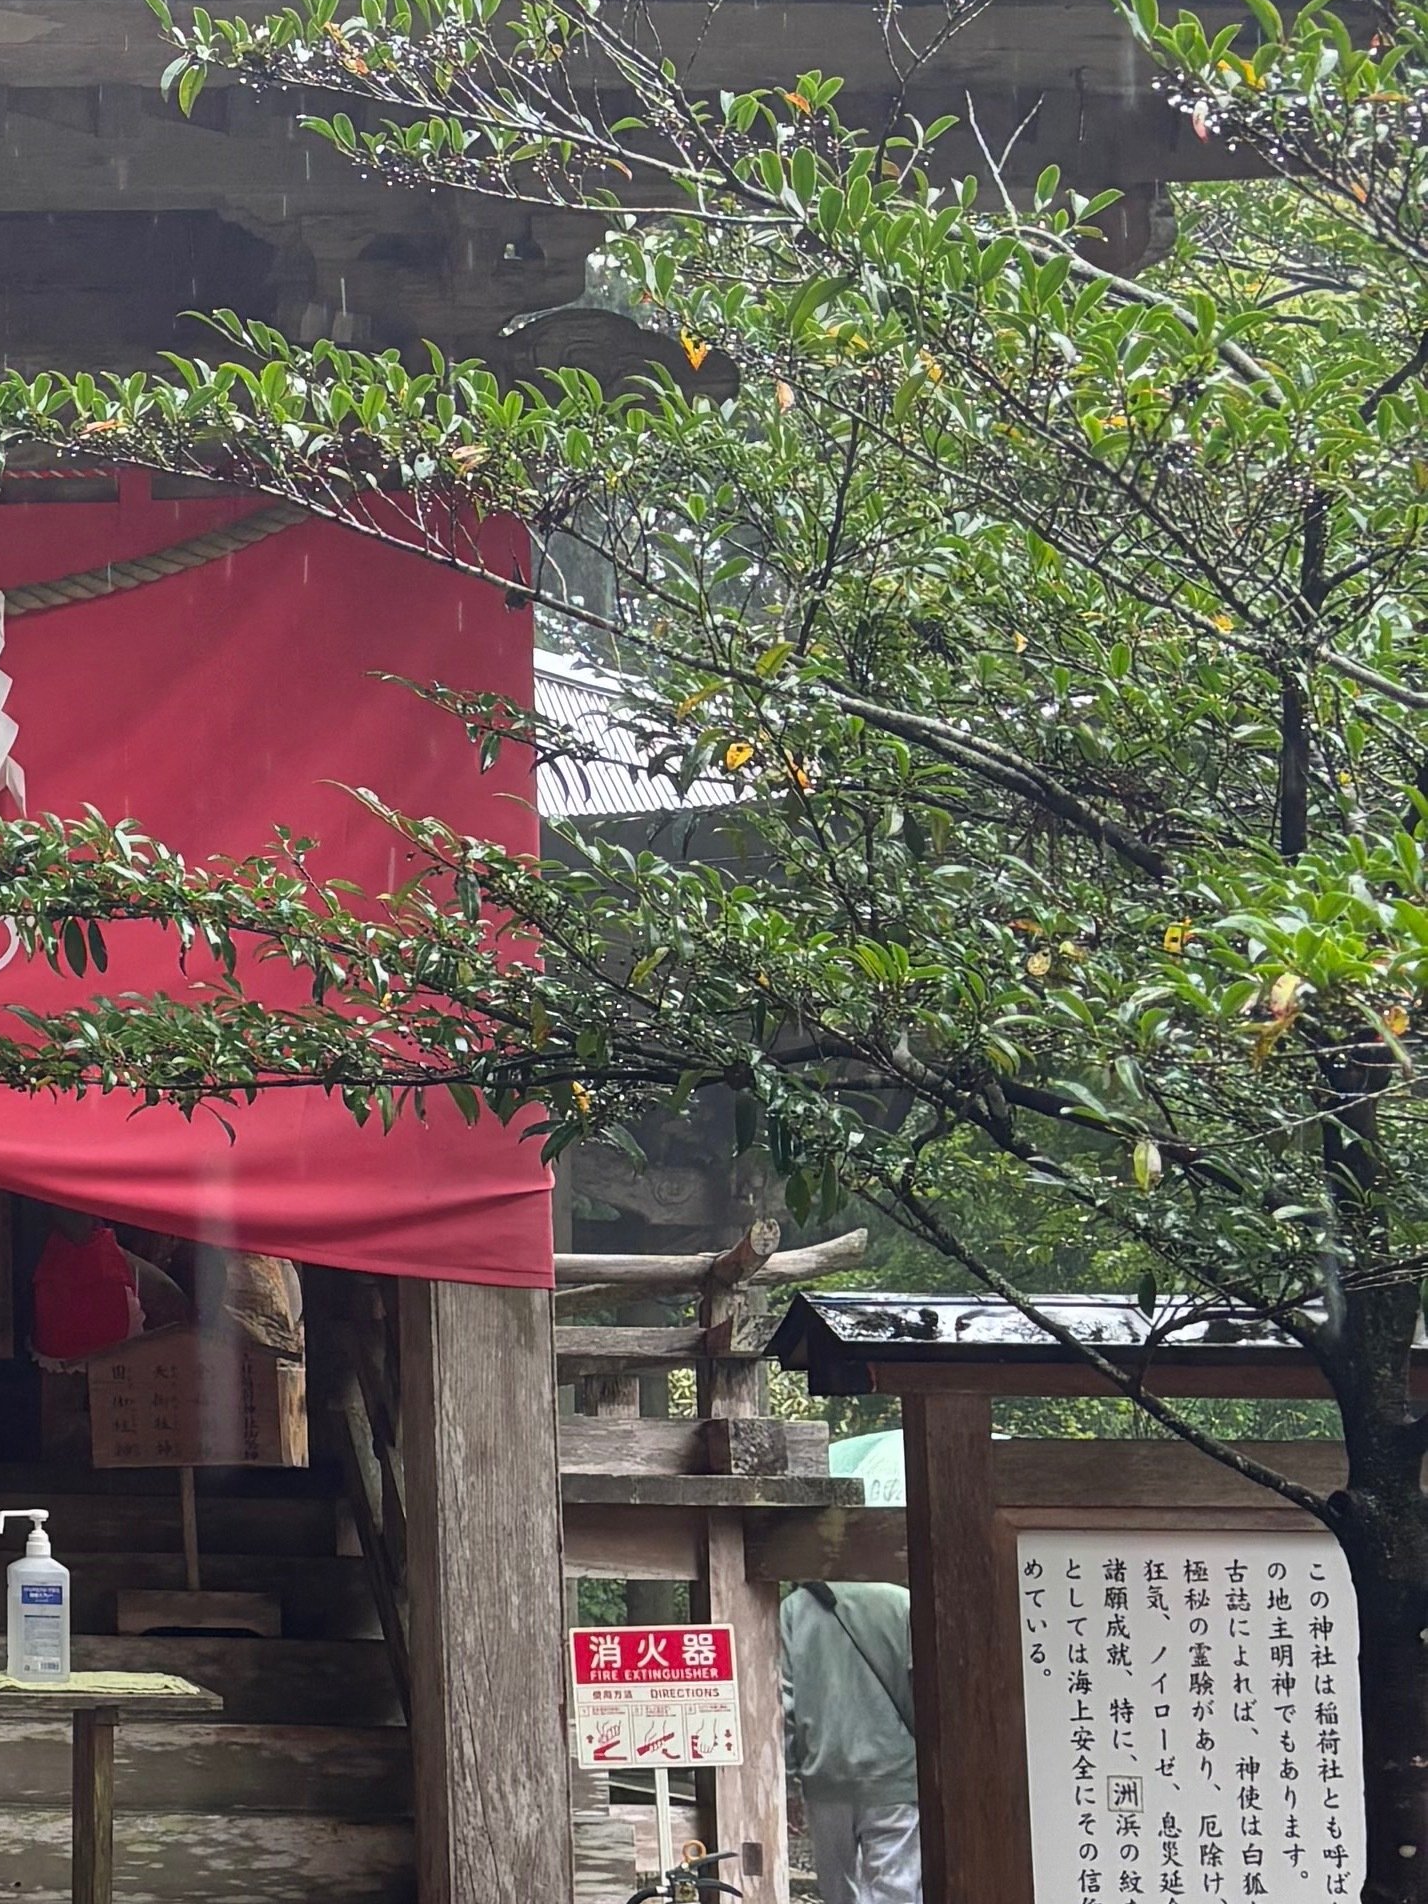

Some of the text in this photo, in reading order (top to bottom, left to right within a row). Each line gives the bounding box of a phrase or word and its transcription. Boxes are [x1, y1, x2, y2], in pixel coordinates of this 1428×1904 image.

[1024, 1558, 1052, 1677] めている。
[589, 1633, 717, 1669] 消火器
[590, 1668, 719, 1681] FIRE EXTINGUISHER
[649, 1688, 720, 1699] DIRECTIONS
